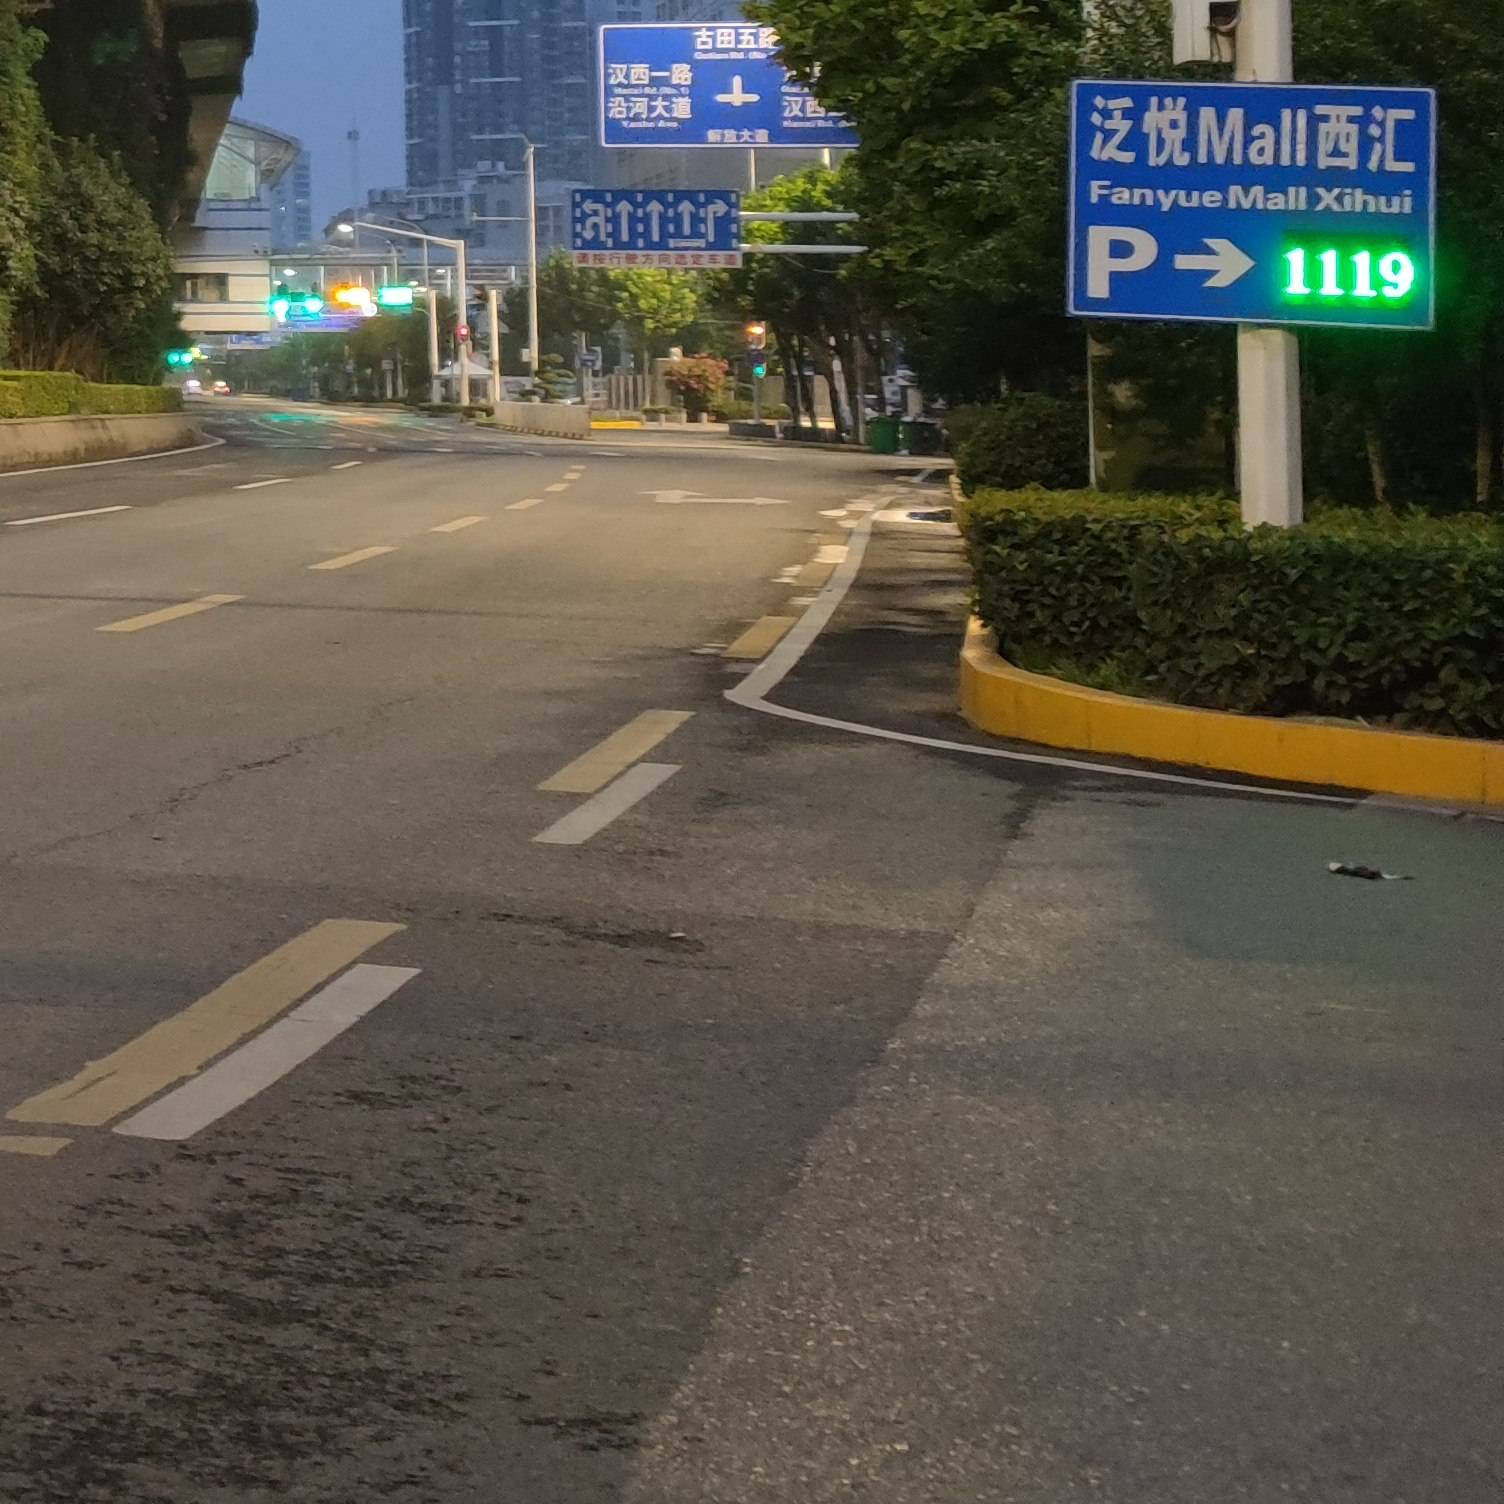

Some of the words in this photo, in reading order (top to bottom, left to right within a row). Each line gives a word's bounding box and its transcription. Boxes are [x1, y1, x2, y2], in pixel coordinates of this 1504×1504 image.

[608, 64, 692, 85] 汉西一路
[608, 96, 692, 119] 沿河大道
[1089, 94, 1417, 173] 泛悦Mall西汇
[1088, 179, 1223, 212] Fanyue
[1227, 184, 1308, 211] Mall
[1313, 186, 1413, 214] Xihui
[1086, 224, 1159, 299] P
[1281, 246, 1416, 298] 1119
